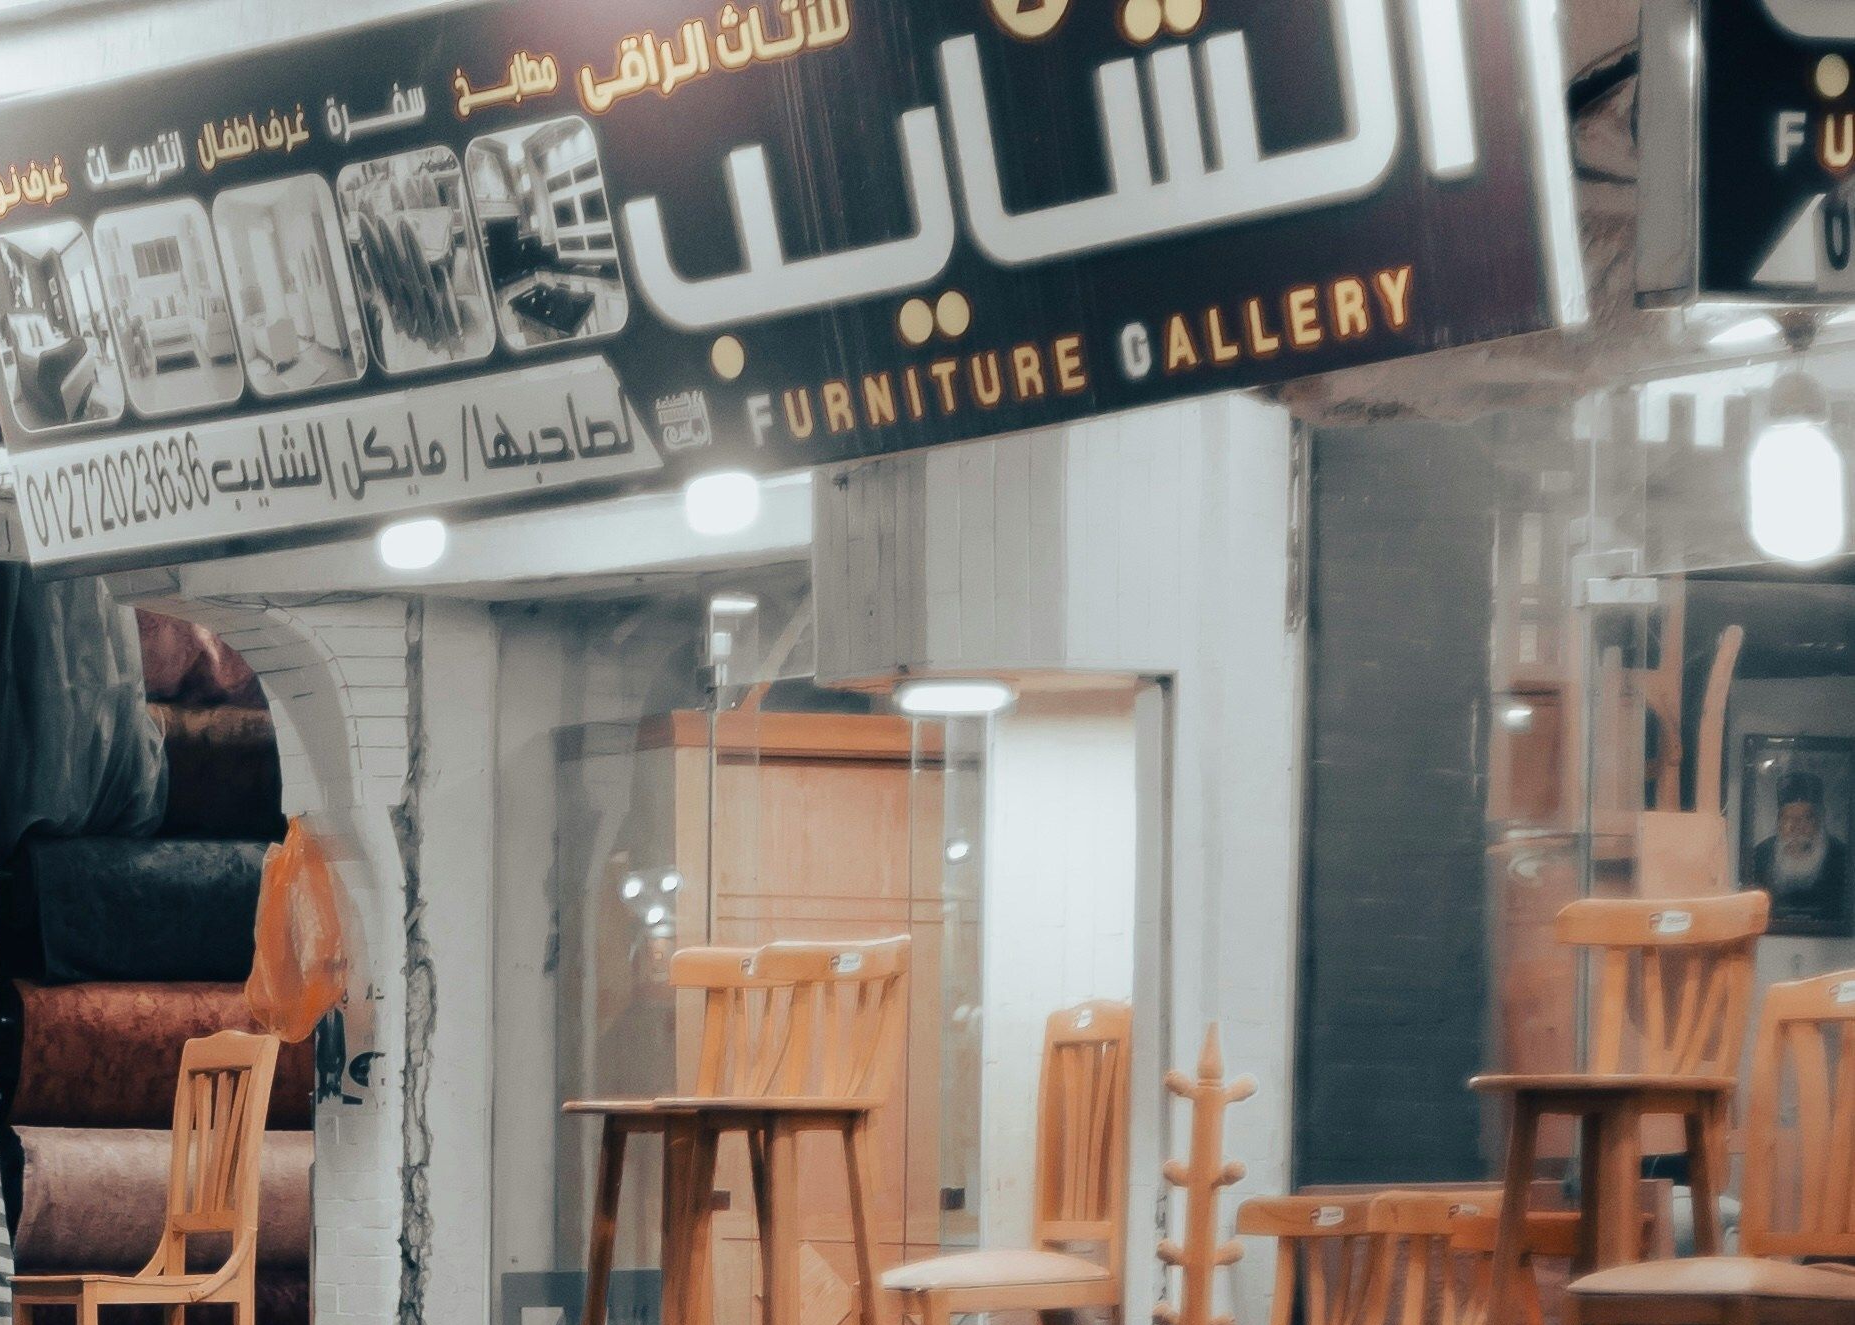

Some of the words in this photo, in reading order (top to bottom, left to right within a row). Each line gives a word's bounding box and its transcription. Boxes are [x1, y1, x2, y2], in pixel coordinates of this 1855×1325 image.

[261, 102, 310, 152] غرف
[454, 50, 559, 118] مطابخ
[20, 155, 69, 204] غرف
[747, 333, 1085, 447] FURNITURE
[1120, 265, 1413, 380] GALLERY
[25, 430, 211, 548] 01272023636
[210, 420, 338, 512] الشايب
[341, 410, 447, 501] مايكل
